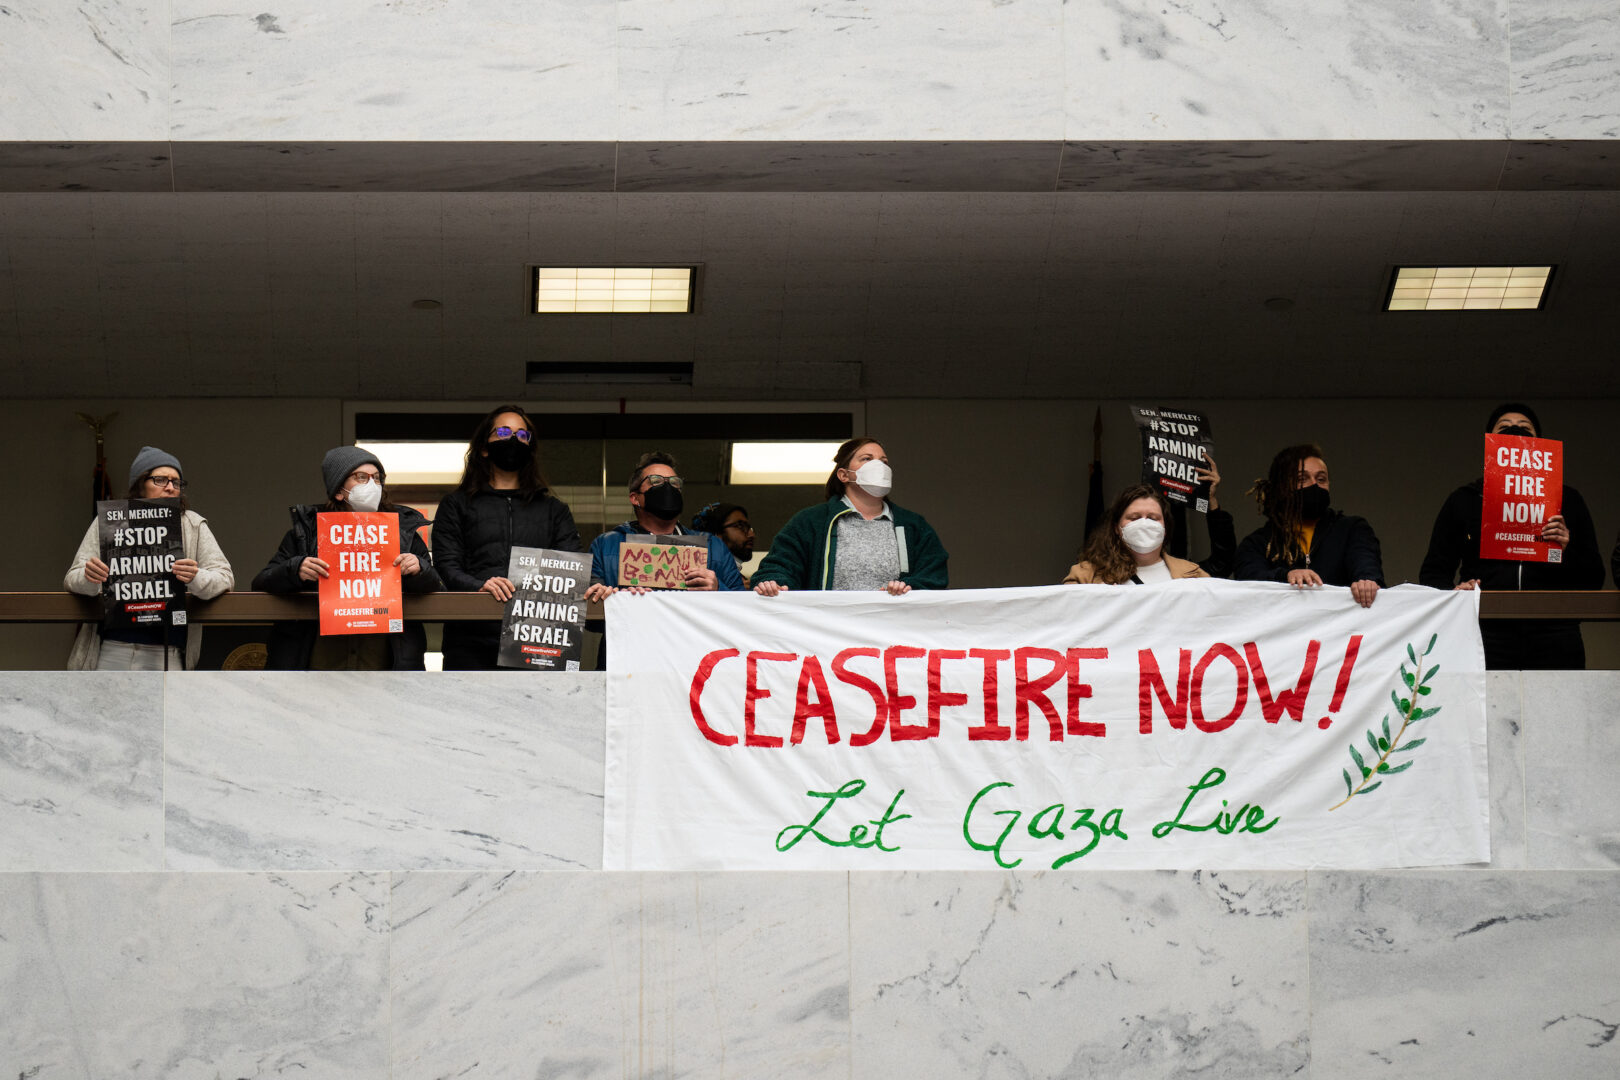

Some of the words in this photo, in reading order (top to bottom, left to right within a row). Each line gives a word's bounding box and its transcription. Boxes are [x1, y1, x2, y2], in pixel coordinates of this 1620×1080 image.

[1140, 409, 1159, 417] SEN.
[1160, 411, 1201, 422] MERKLEY:
[1150, 419, 1199, 437] #STOP
[1149, 436, 1207, 462] ARMING
[1497, 447, 1553, 472] CEASE
[1153, 455, 1201, 485] ISRAEL
[1504, 474, 1545, 497] FIRE
[107, 510, 126, 520] SEN.
[129, 508, 172, 520] MERKLEY:
[1502, 502, 1545, 524] NOW
[114, 526, 168, 547] #STOP
[330, 524, 389, 545] CEASE
[1495, 532, 1546, 542] #CEASEFIRENO
[109, 554, 176, 576] ARMING
[340, 552, 381, 573] FIRE
[519, 556, 538, 567] SEN.
[541, 558, 584, 571] MERKLEY:
[657, 548, 708, 571] MORE
[115, 580, 174, 601] ISRAEL
[340, 579, 382, 599] NOW
[522, 573, 576, 595] #STOP
[334, 607, 389, 616] #CEASEFIRENOW
[512, 599, 579, 623] ARMING
[513, 623, 571, 647] ISRAEL
[689, 645, 1109, 748] CEASEFIRE
[1138, 635, 1363, 734] NOW!
[776, 779, 912, 852] Let
[963, 782, 1128, 870] Gaza
[1152, 767, 1283, 839] Live
